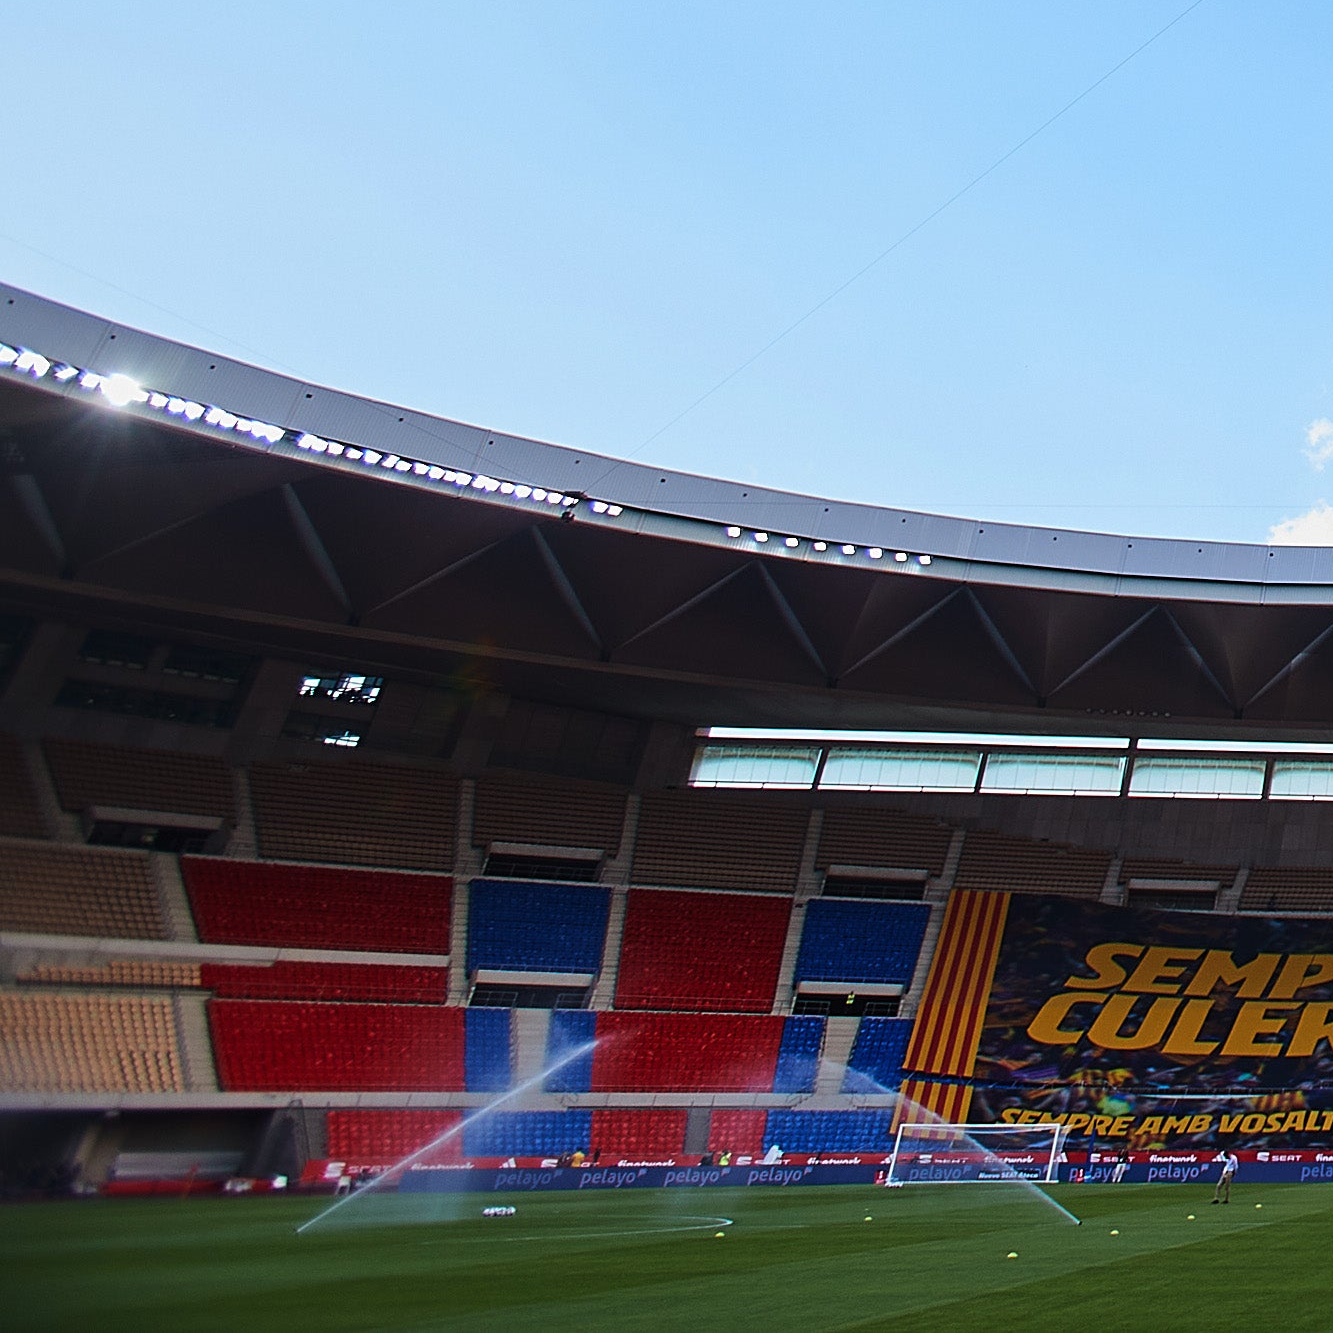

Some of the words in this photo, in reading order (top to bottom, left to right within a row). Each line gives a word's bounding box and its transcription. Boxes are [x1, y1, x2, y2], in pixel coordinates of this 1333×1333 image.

[998, 1108, 1132, 1137] SEMPRE
[1135, 1110, 1215, 1134] AMB
[1271, 1154, 1303, 1162] SEAT
[494, 1170, 551, 1190] pelayo
[579, 1168, 637, 1188] pelayo
[663, 1167, 720, 1187] pelayo
[747, 1166, 803, 1186] pelayo
[1148, 1164, 1199, 1183] pelayo
